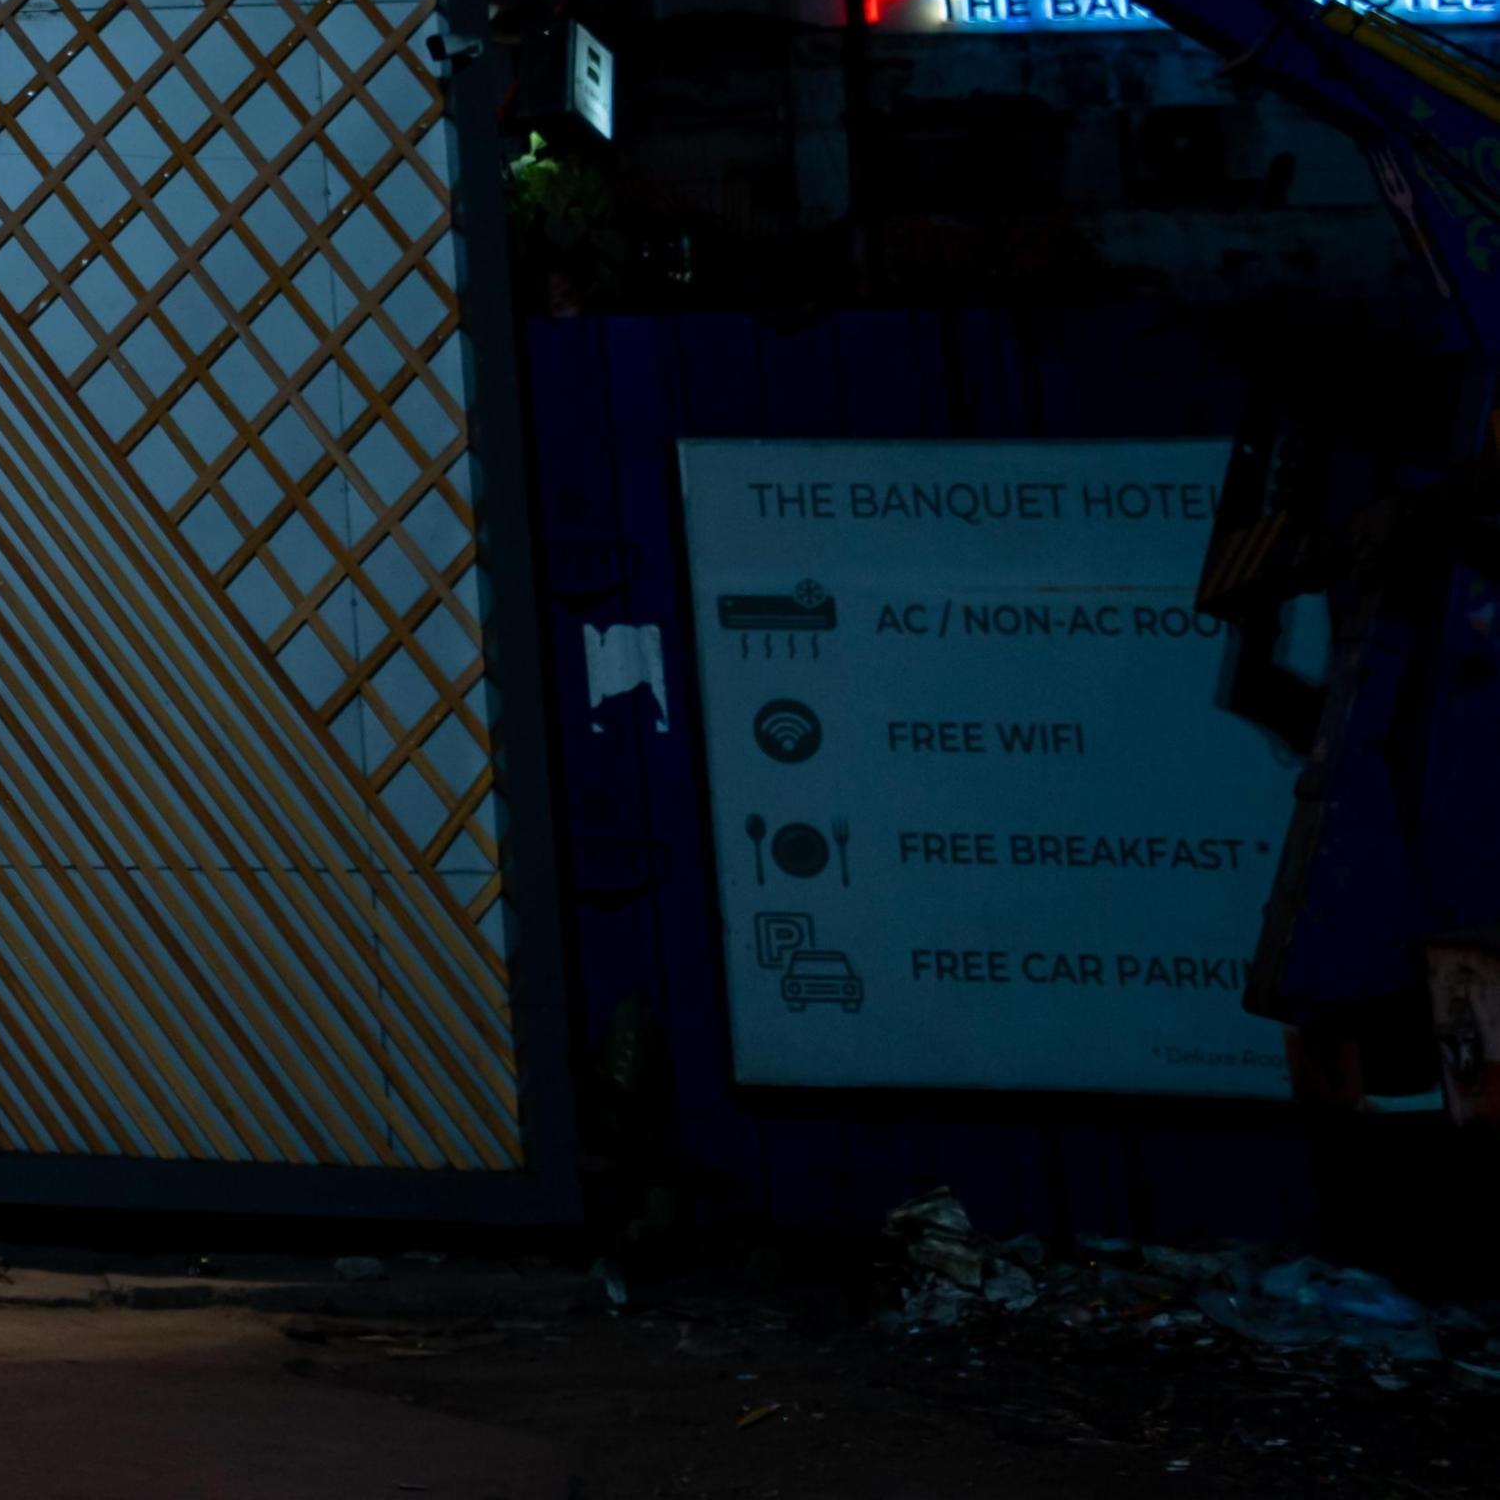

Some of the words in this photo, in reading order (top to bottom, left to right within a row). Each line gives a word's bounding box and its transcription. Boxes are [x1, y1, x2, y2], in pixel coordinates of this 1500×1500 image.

[749, 483, 836, 519] THE
[850, 483, 1066, 525] BANQUET
[876, 604, 928, 635] AC
[964, 604, 1120, 636] NON-AC
[1134, 605, 1232, 637] ROO
[888, 722, 986, 753] FREE
[996, 722, 1085, 755] WIFI
[900, 832, 998, 864] FREE
[1009, 832, 1244, 870] BREAKFAST
[912, 950, 1010, 984] FREE
[1021, 951, 1105, 988] CAR
